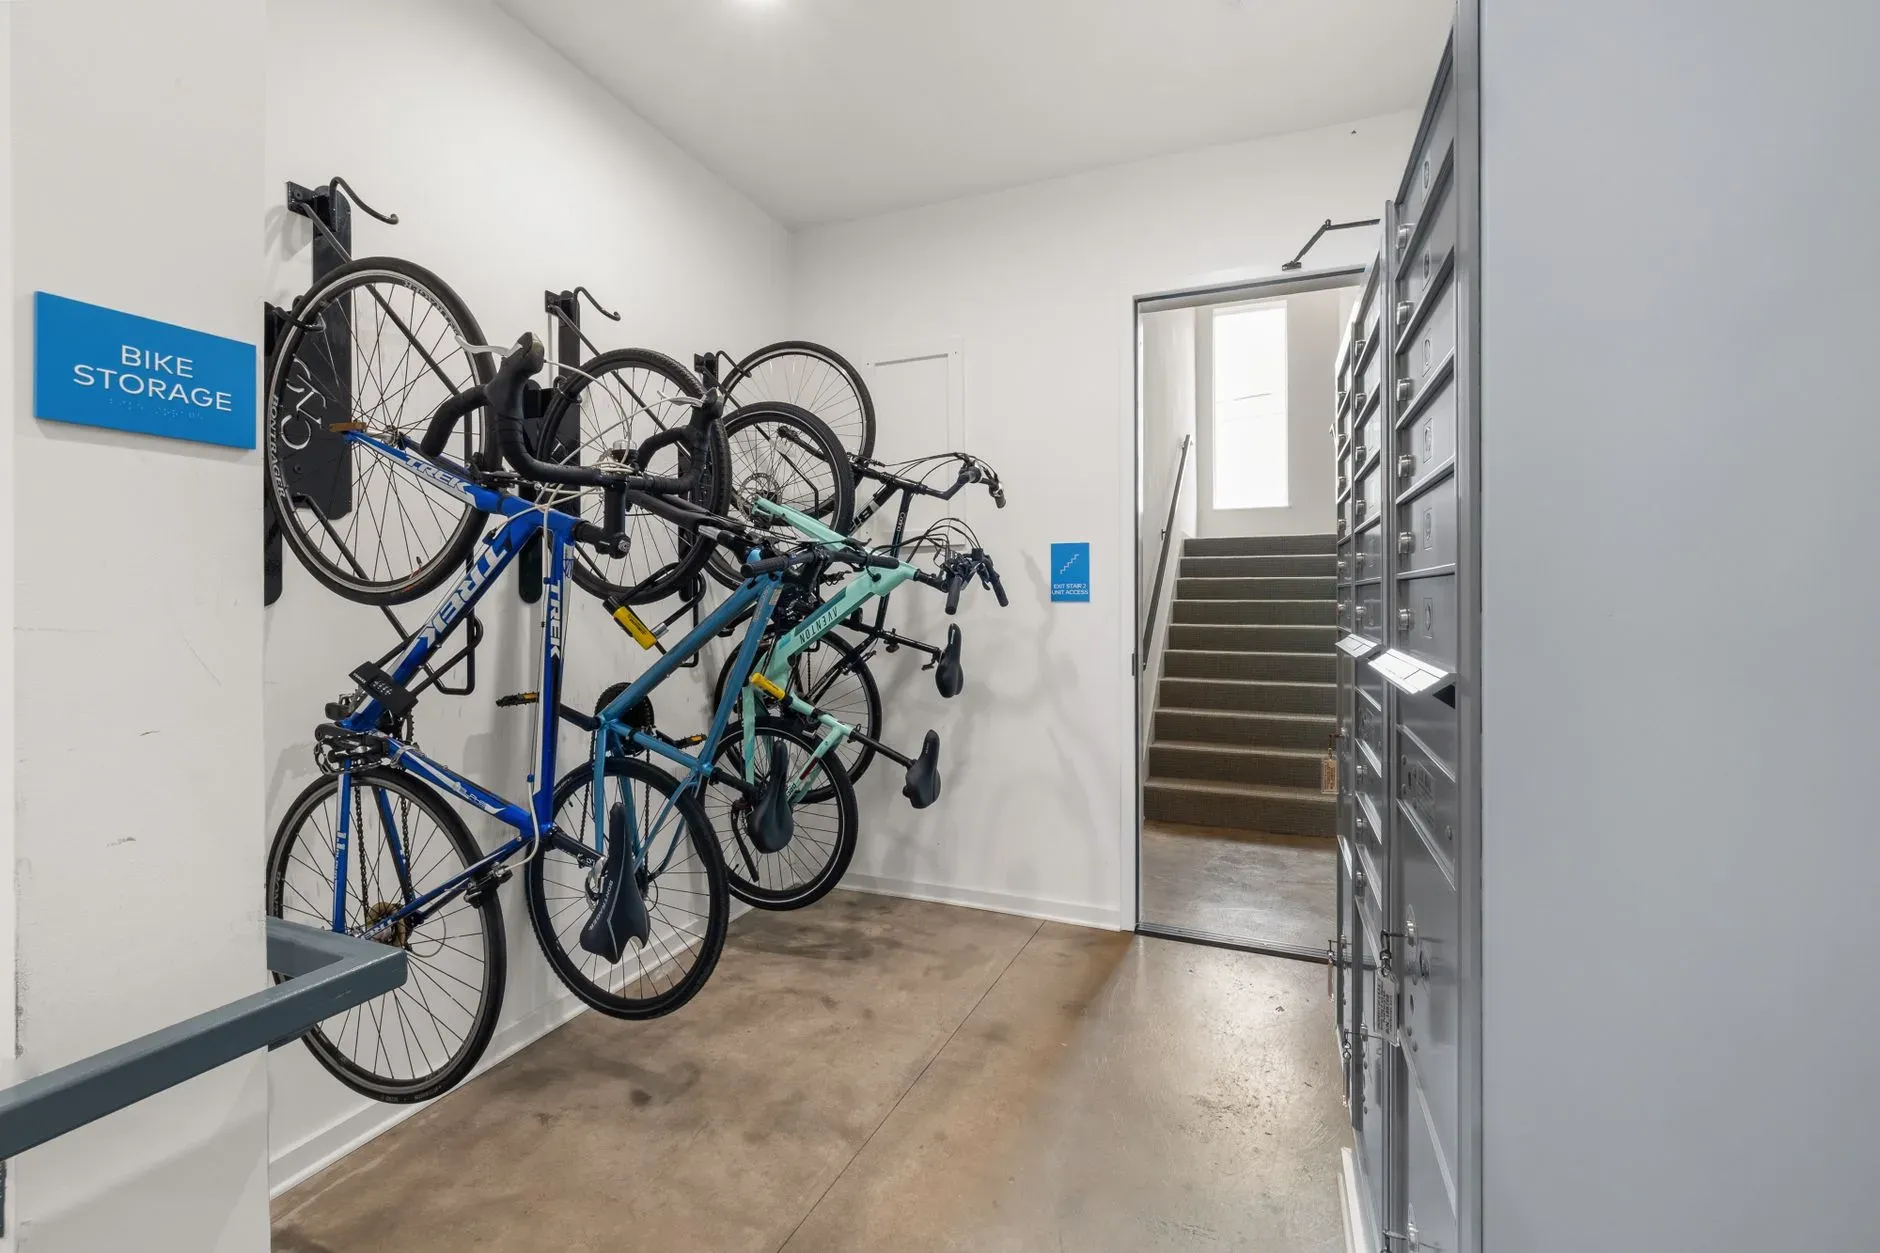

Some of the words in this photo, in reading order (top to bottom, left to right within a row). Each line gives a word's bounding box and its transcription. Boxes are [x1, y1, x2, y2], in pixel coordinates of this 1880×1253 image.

[121, 344, 193, 379] BIKE
[73, 364, 232, 412] STORAGE
[270, 394, 286, 498] BONTRAGER
[405, 456, 472, 495] TREK
[418, 546, 508, 649] TREK
[549, 579, 561, 658] TREK
[799, 606, 838, 645] AVENTON
